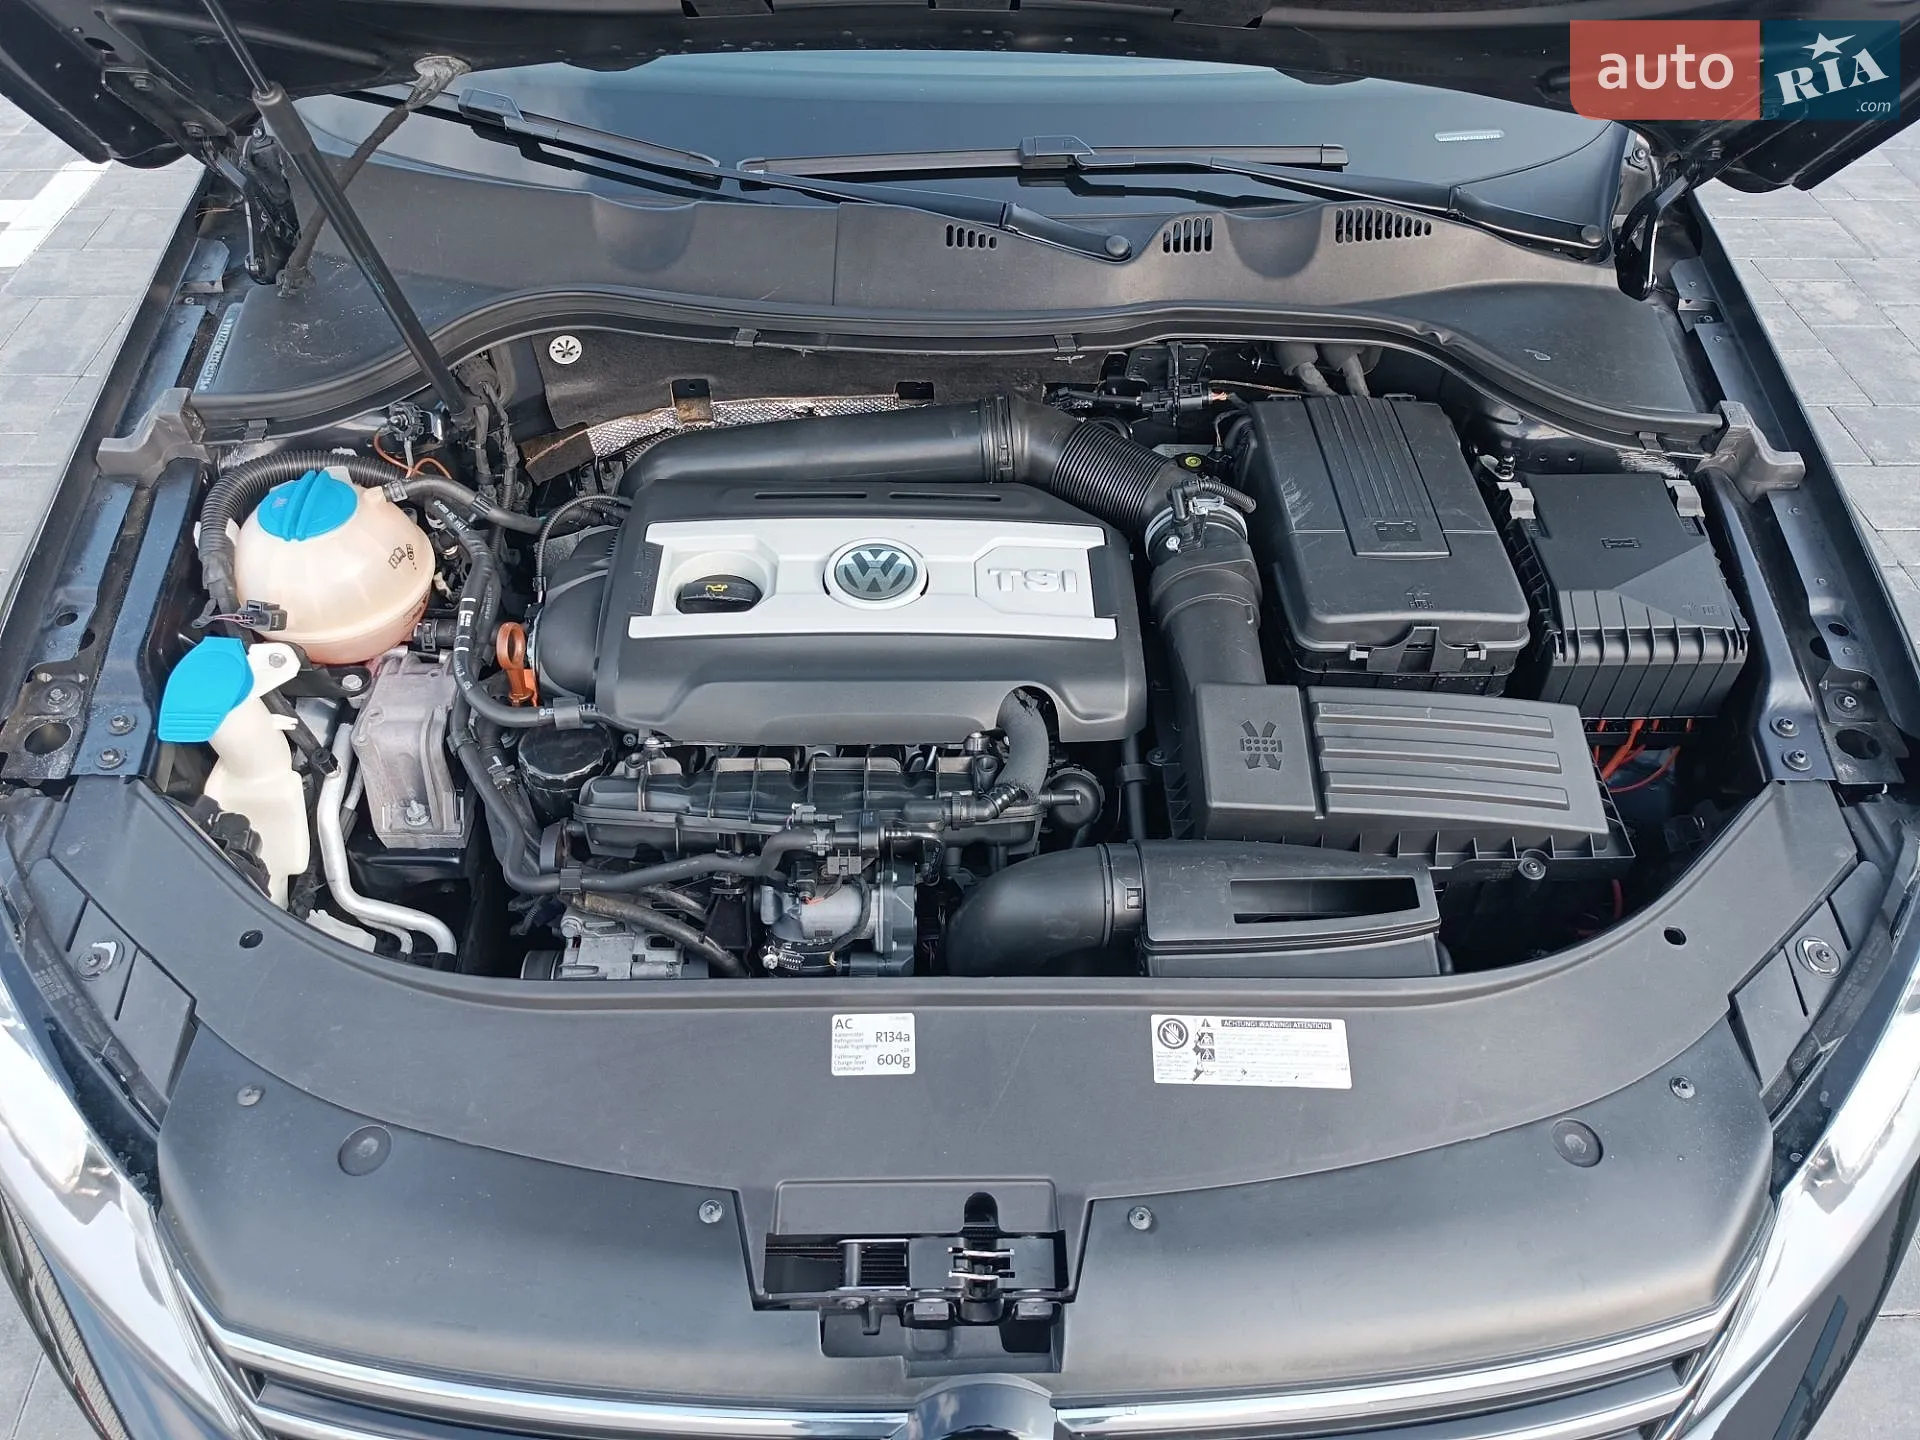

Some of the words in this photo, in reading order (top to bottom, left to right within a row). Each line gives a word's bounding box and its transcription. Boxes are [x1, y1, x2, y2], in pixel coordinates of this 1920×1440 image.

[834, 543, 918, 601] VW
[987, 568, 1078, 593] TSI
[835, 1018, 853, 1030] AC
[875, 1031, 910, 1043] R134a
[877, 1053, 911, 1069] 600g
